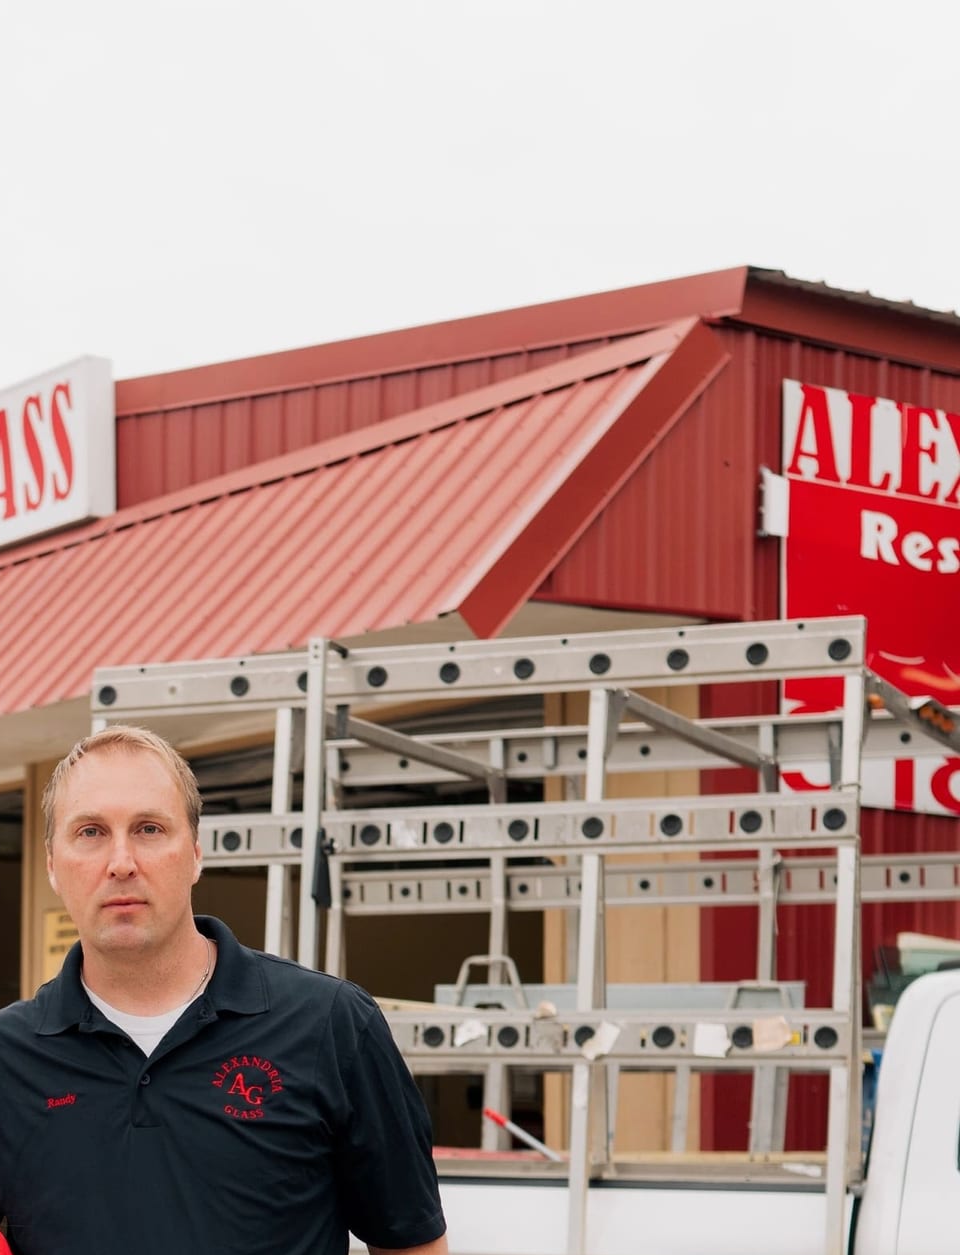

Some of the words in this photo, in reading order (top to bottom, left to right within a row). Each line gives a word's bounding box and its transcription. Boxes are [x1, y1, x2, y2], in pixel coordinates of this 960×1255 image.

[212, 1055, 283, 1094] ALEXANDRIA
[47, 1093, 77, 1108] Randy
[227, 1072, 264, 1105] AG
[224, 1104, 265, 1119] GLASS
